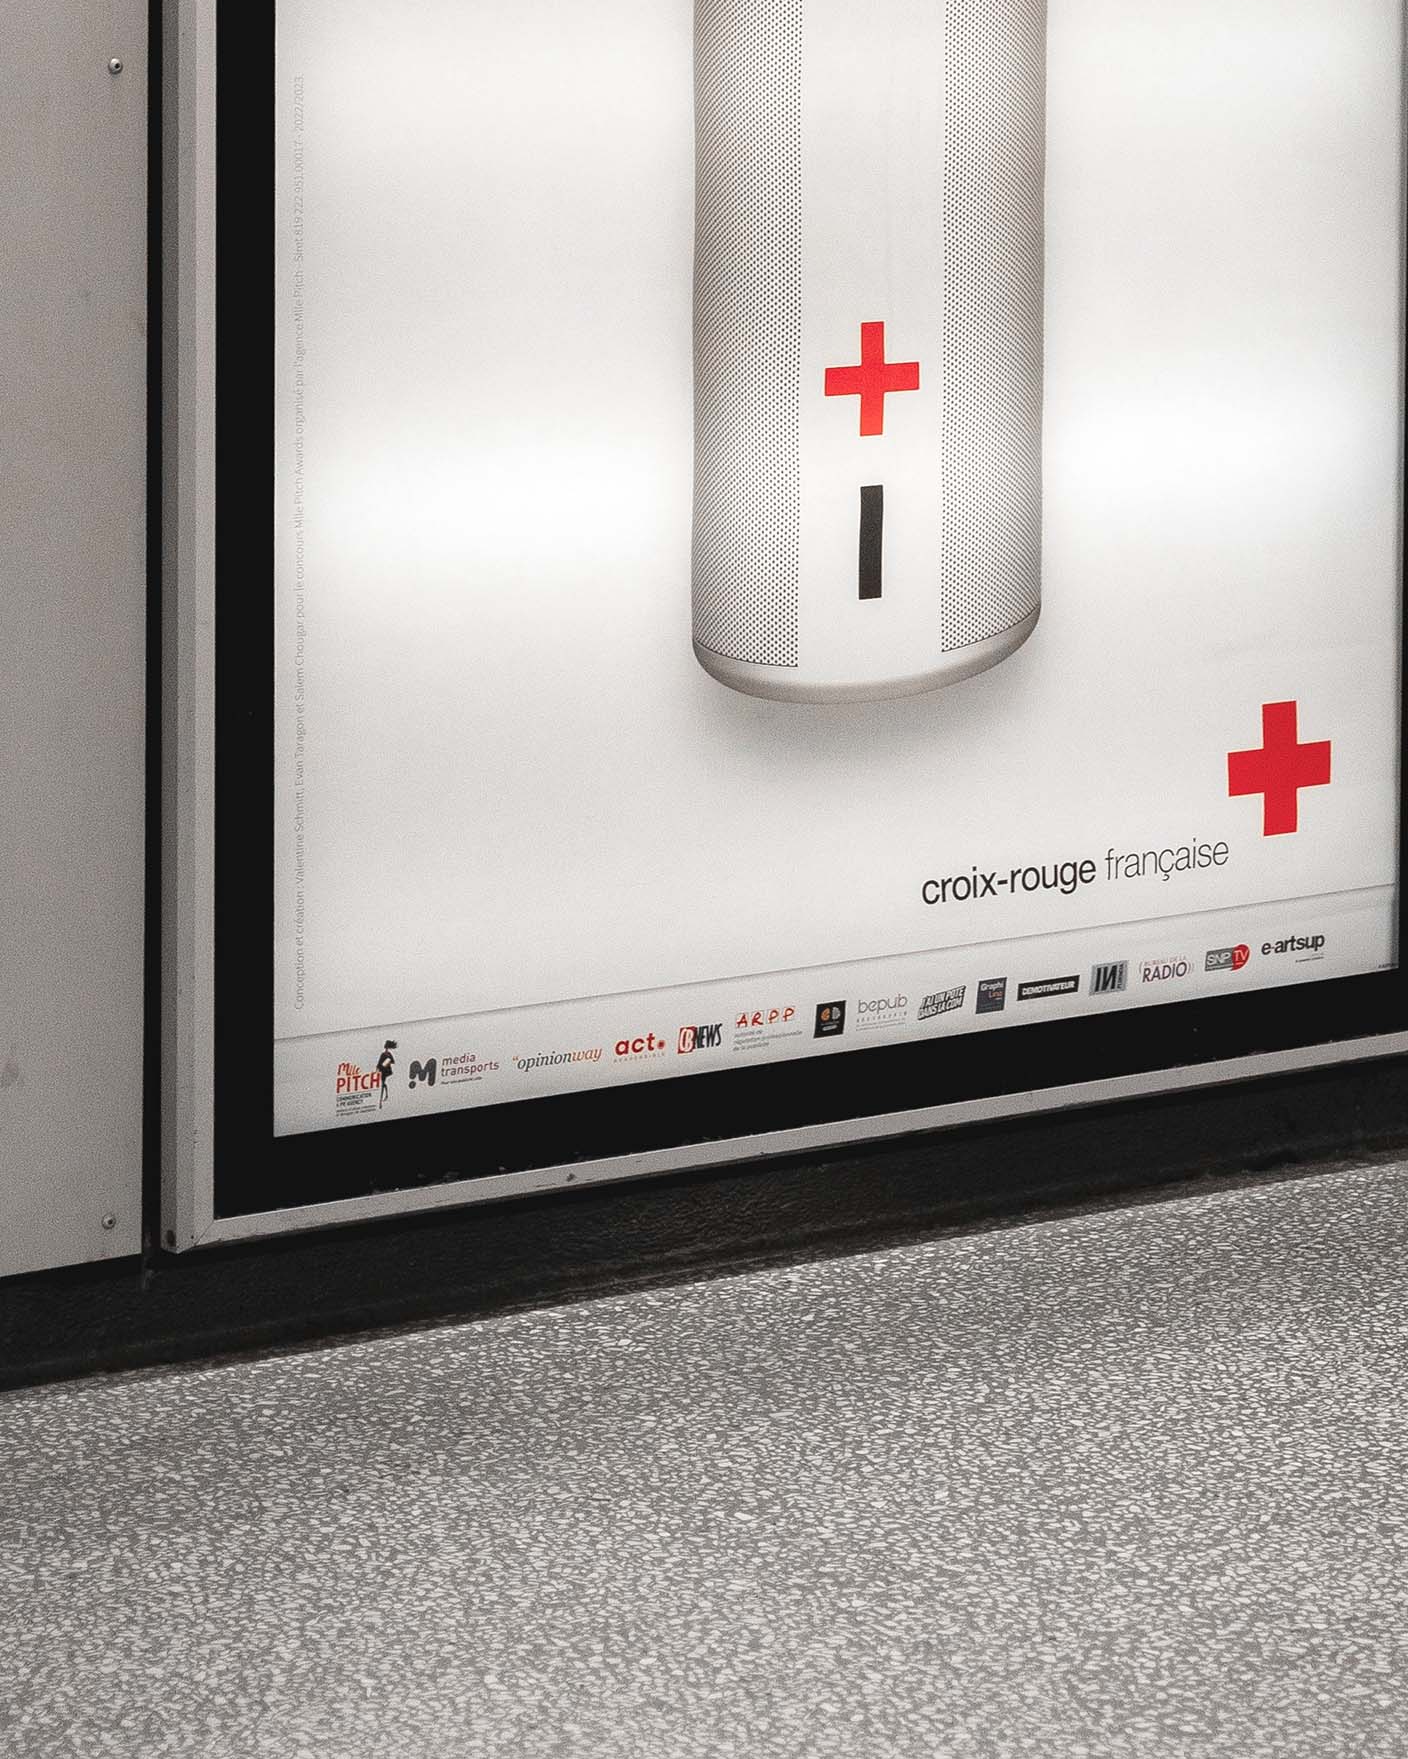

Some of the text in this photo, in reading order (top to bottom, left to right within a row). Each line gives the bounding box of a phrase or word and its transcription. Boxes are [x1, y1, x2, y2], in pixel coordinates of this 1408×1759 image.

[293, 369, 306, 385] par
[293, 435, 304, 475] Awards
[293, 528, 304, 579] concours
[293, 581, 304, 591] le
[293, 592, 306, 618] pour
[293, 702, 304, 713] et
[293, 759, 304, 786] Evan
[293, 832, 304, 884] Valentine
[921, 837, 1230, 906] croix-rouge française
[293, 890, 304, 934] création
[293, 934, 304, 946] et
[293, 947, 306, 1010] Conception
[1142, 961, 1188, 983] RADIO
[858, 993, 908, 1014] bepub
[736, 1006, 795, 1029] ARPP
[441, 1052, 476, 1066] media
[441, 1060, 500, 1078] transports
[336, 1072, 382, 1094] PITCH
